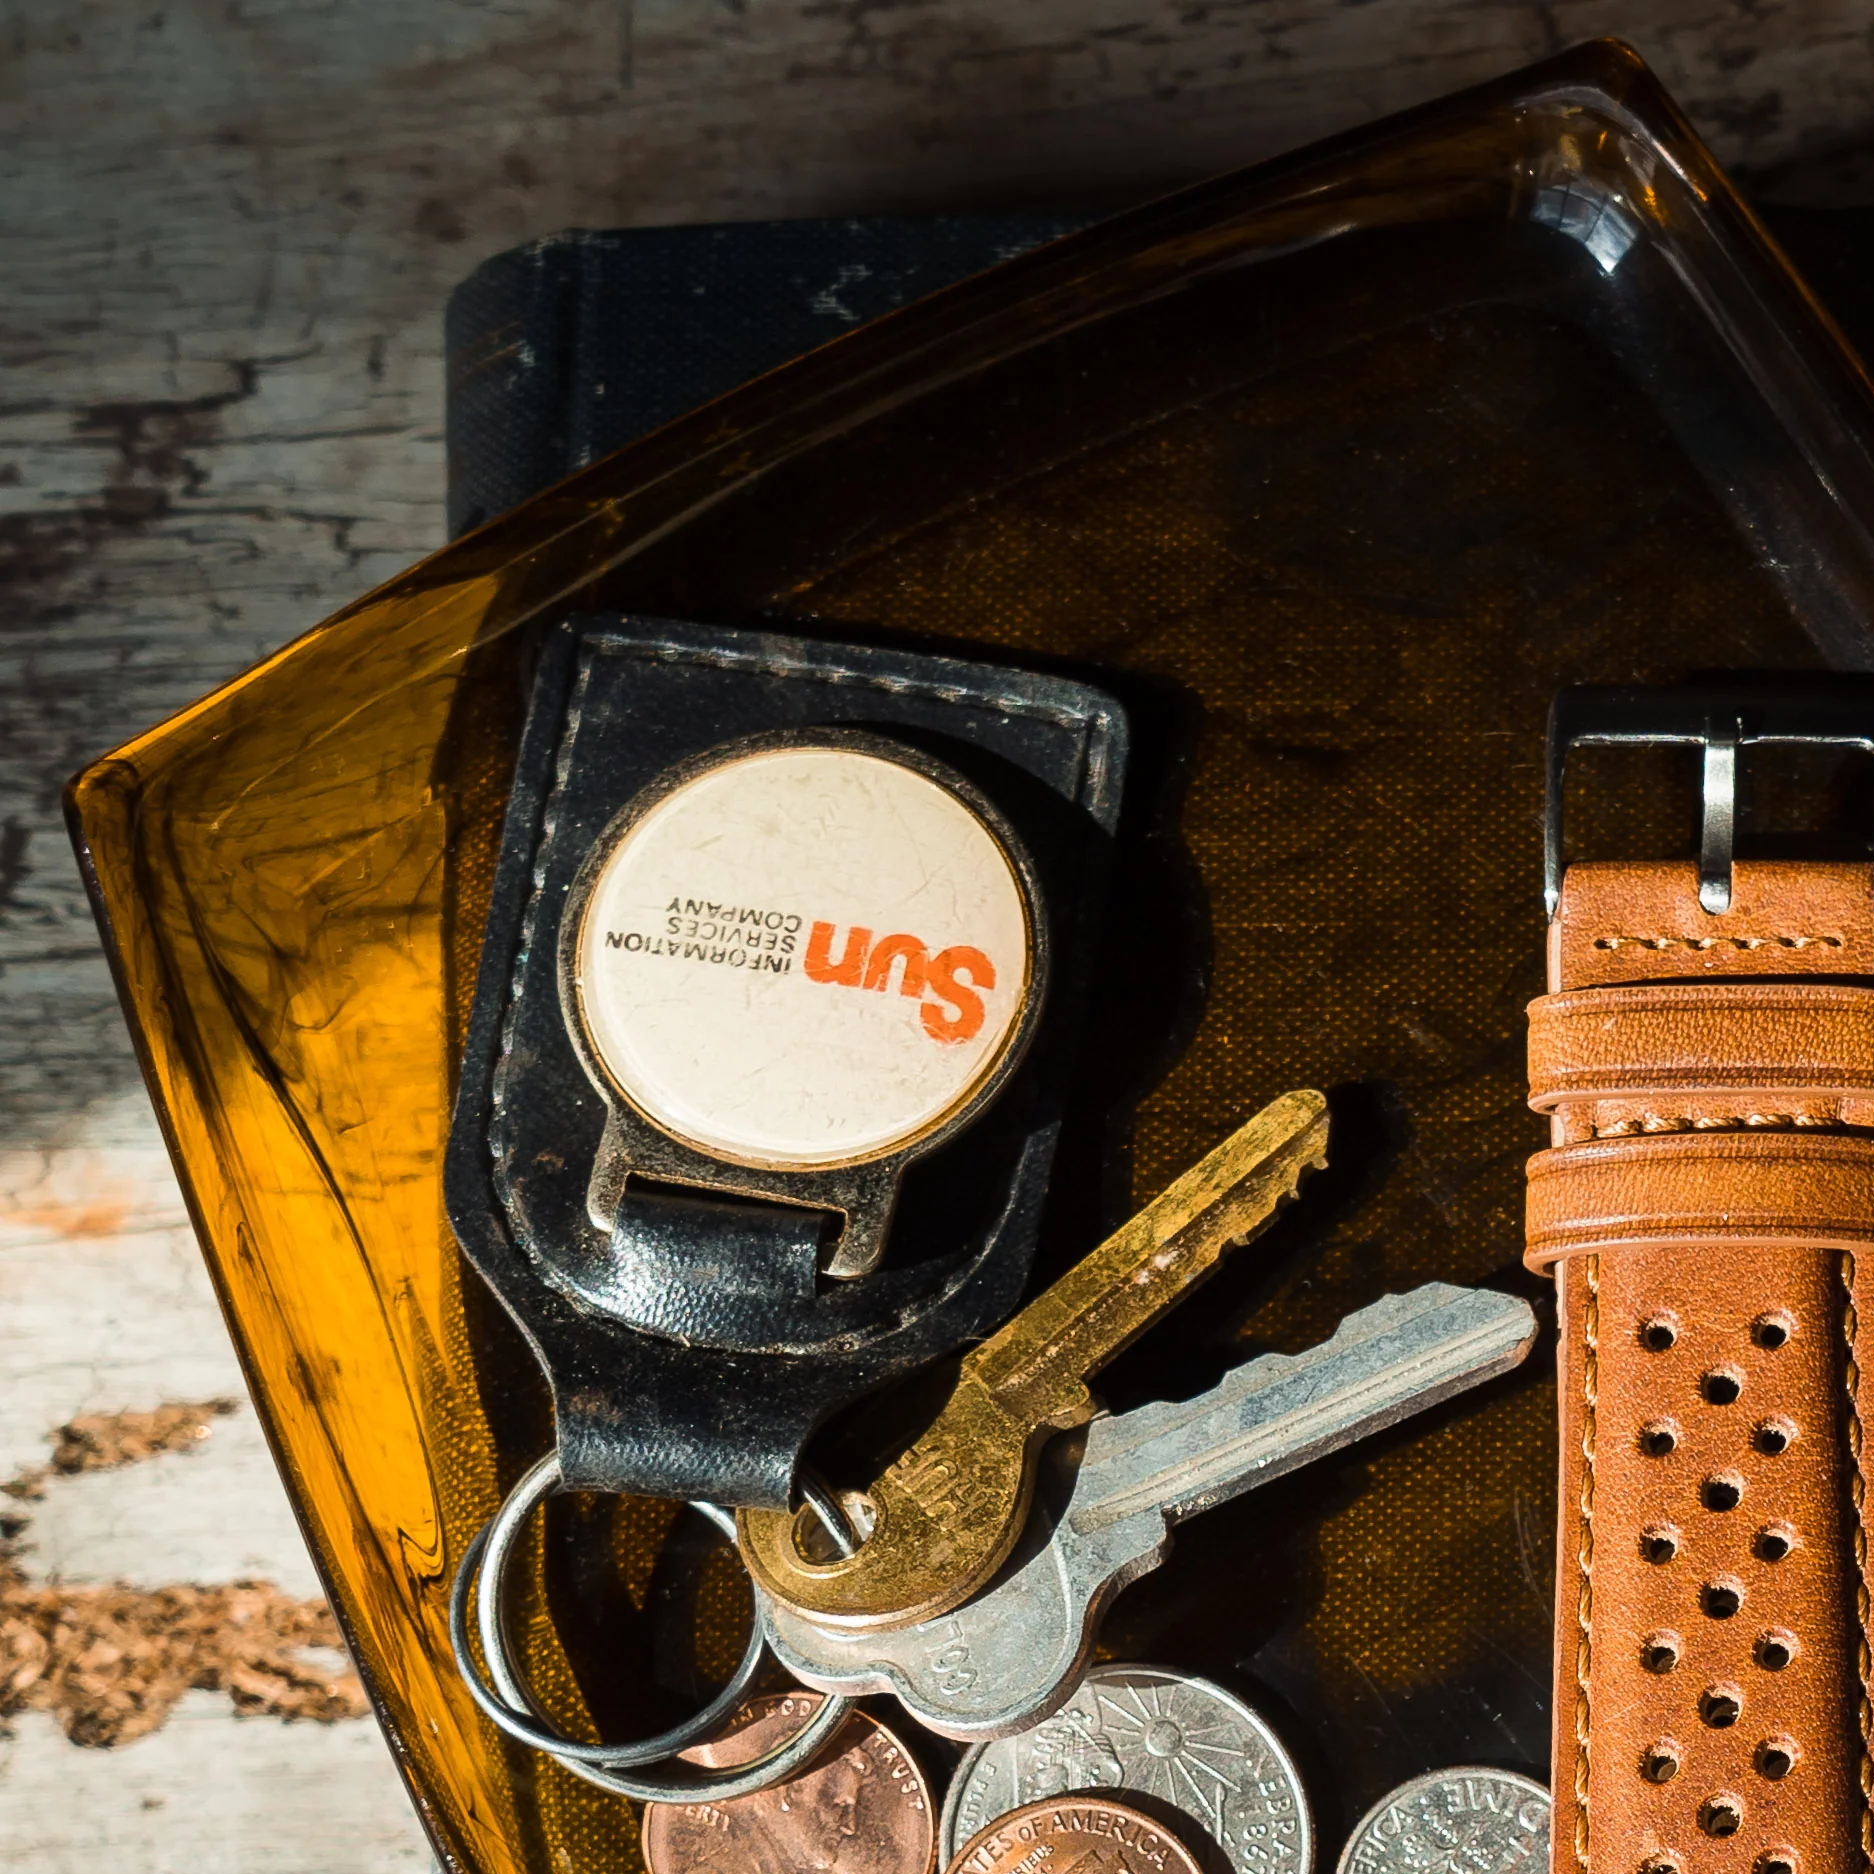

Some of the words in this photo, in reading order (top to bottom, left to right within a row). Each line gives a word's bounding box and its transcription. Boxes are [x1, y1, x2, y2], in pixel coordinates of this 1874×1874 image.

[666, 896, 803, 932] COMPANY
[667, 915, 797, 954] SERVICES
[604, 929, 793, 975] INFORMATION
[804, 920, 996, 1046] Sun
[872, 1730, 926, 1810] TRUST
[1018, 1815, 1044, 1842] OF
[1049, 1809, 1173, 1871] AMERICA
